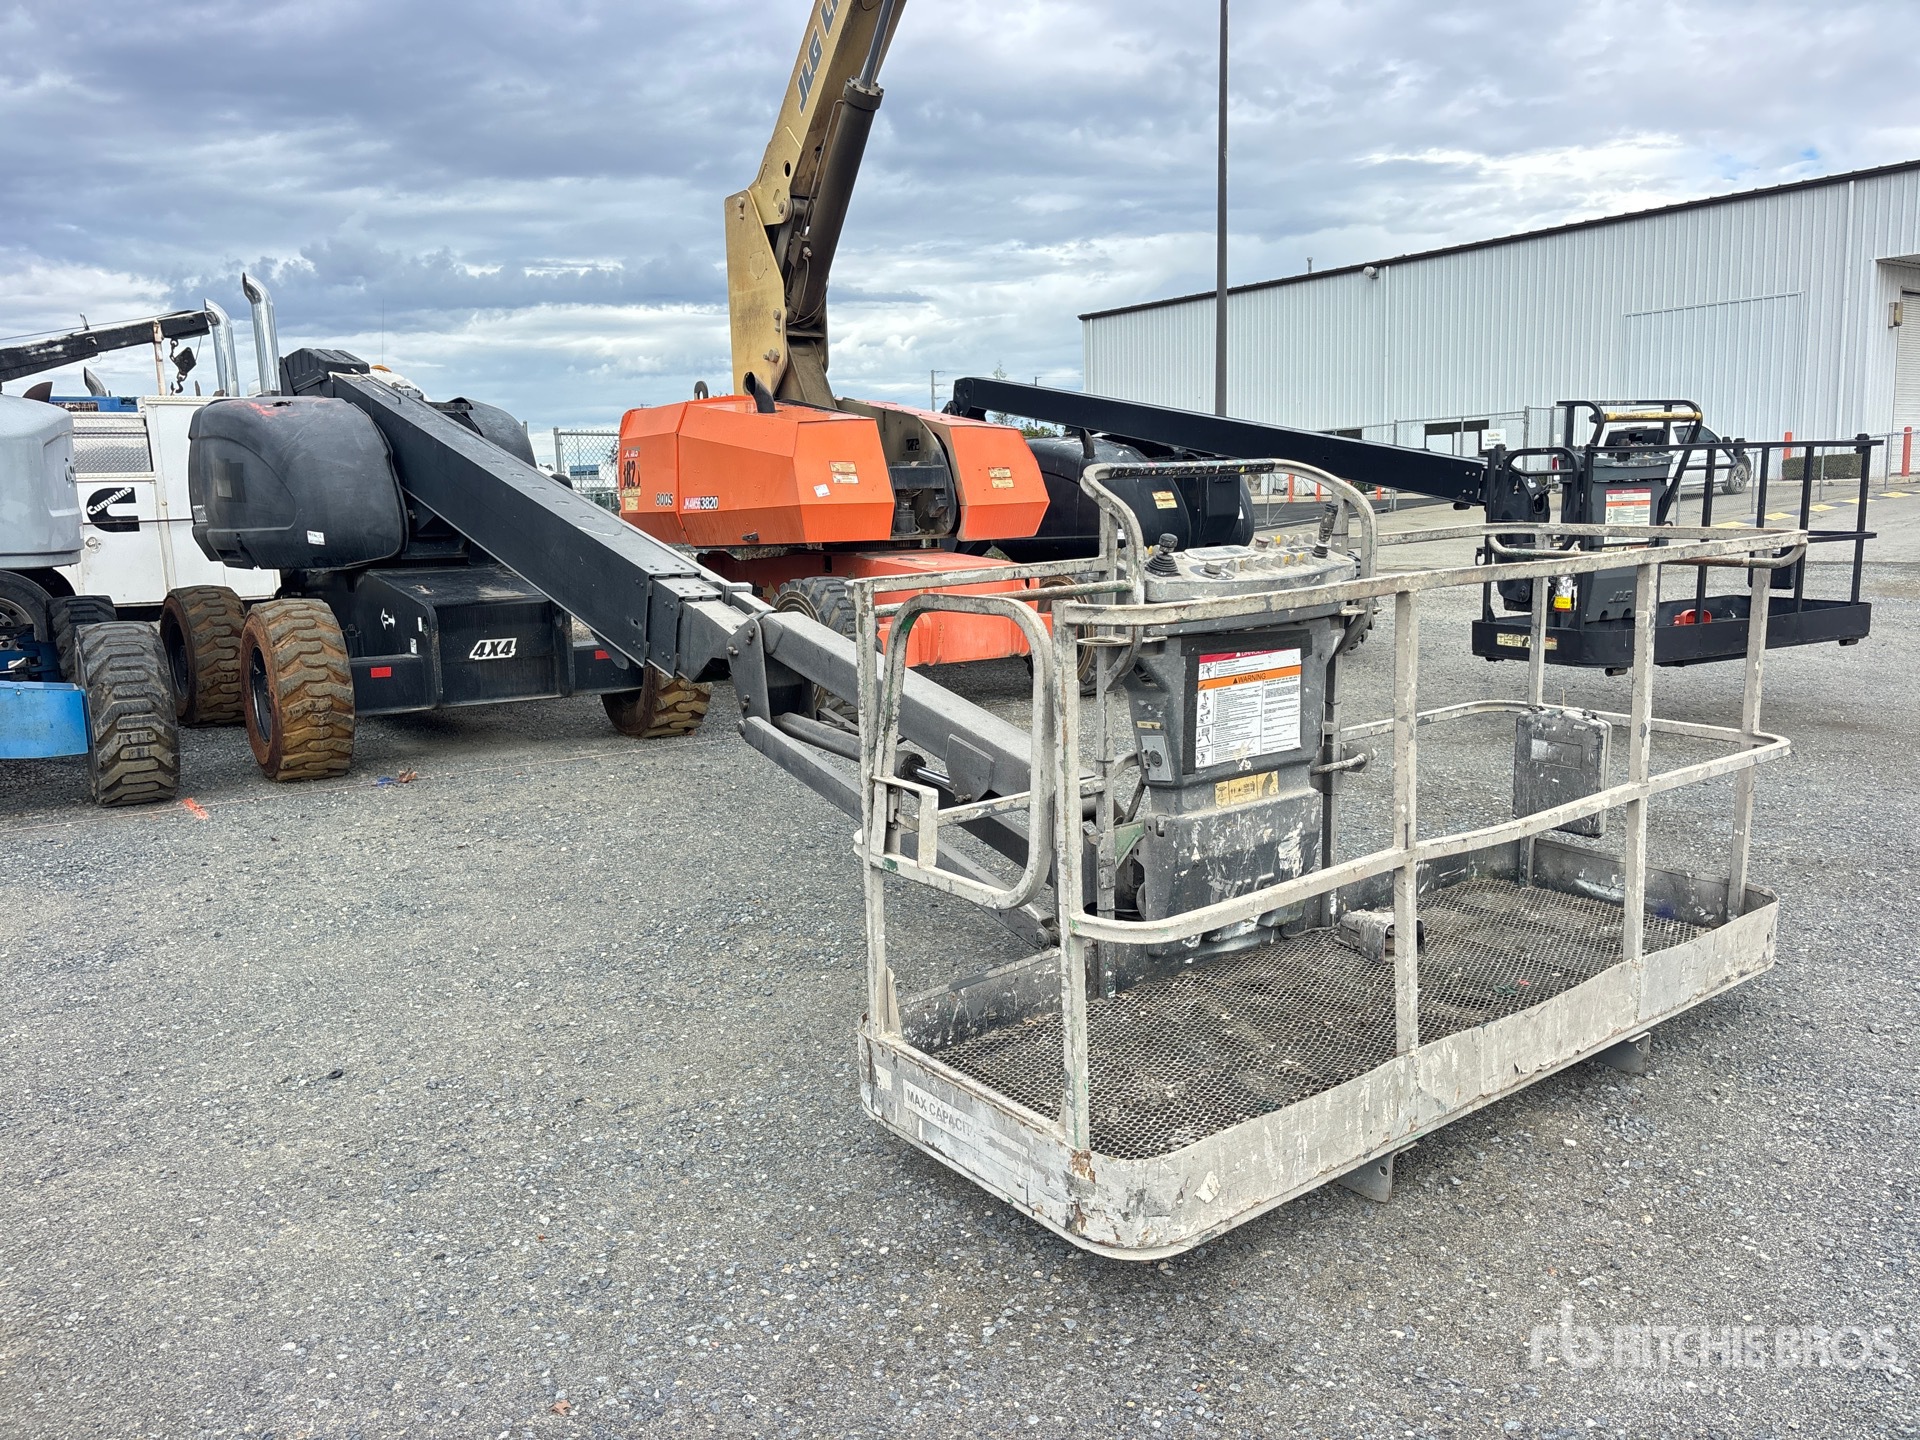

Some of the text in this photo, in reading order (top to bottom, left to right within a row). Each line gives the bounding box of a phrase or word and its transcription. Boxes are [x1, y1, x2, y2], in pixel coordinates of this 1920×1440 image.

[797, 25, 823, 117] JLG
[87, 487, 132, 515] Cummins
[656, 493, 673, 506] 800S
[700, 496, 718, 509] 3820
[472, 639, 514, 658] 4X4
[1238, 672, 1267, 683] WARNING
[907, 1088, 977, 1138] MAX CAPACIT
